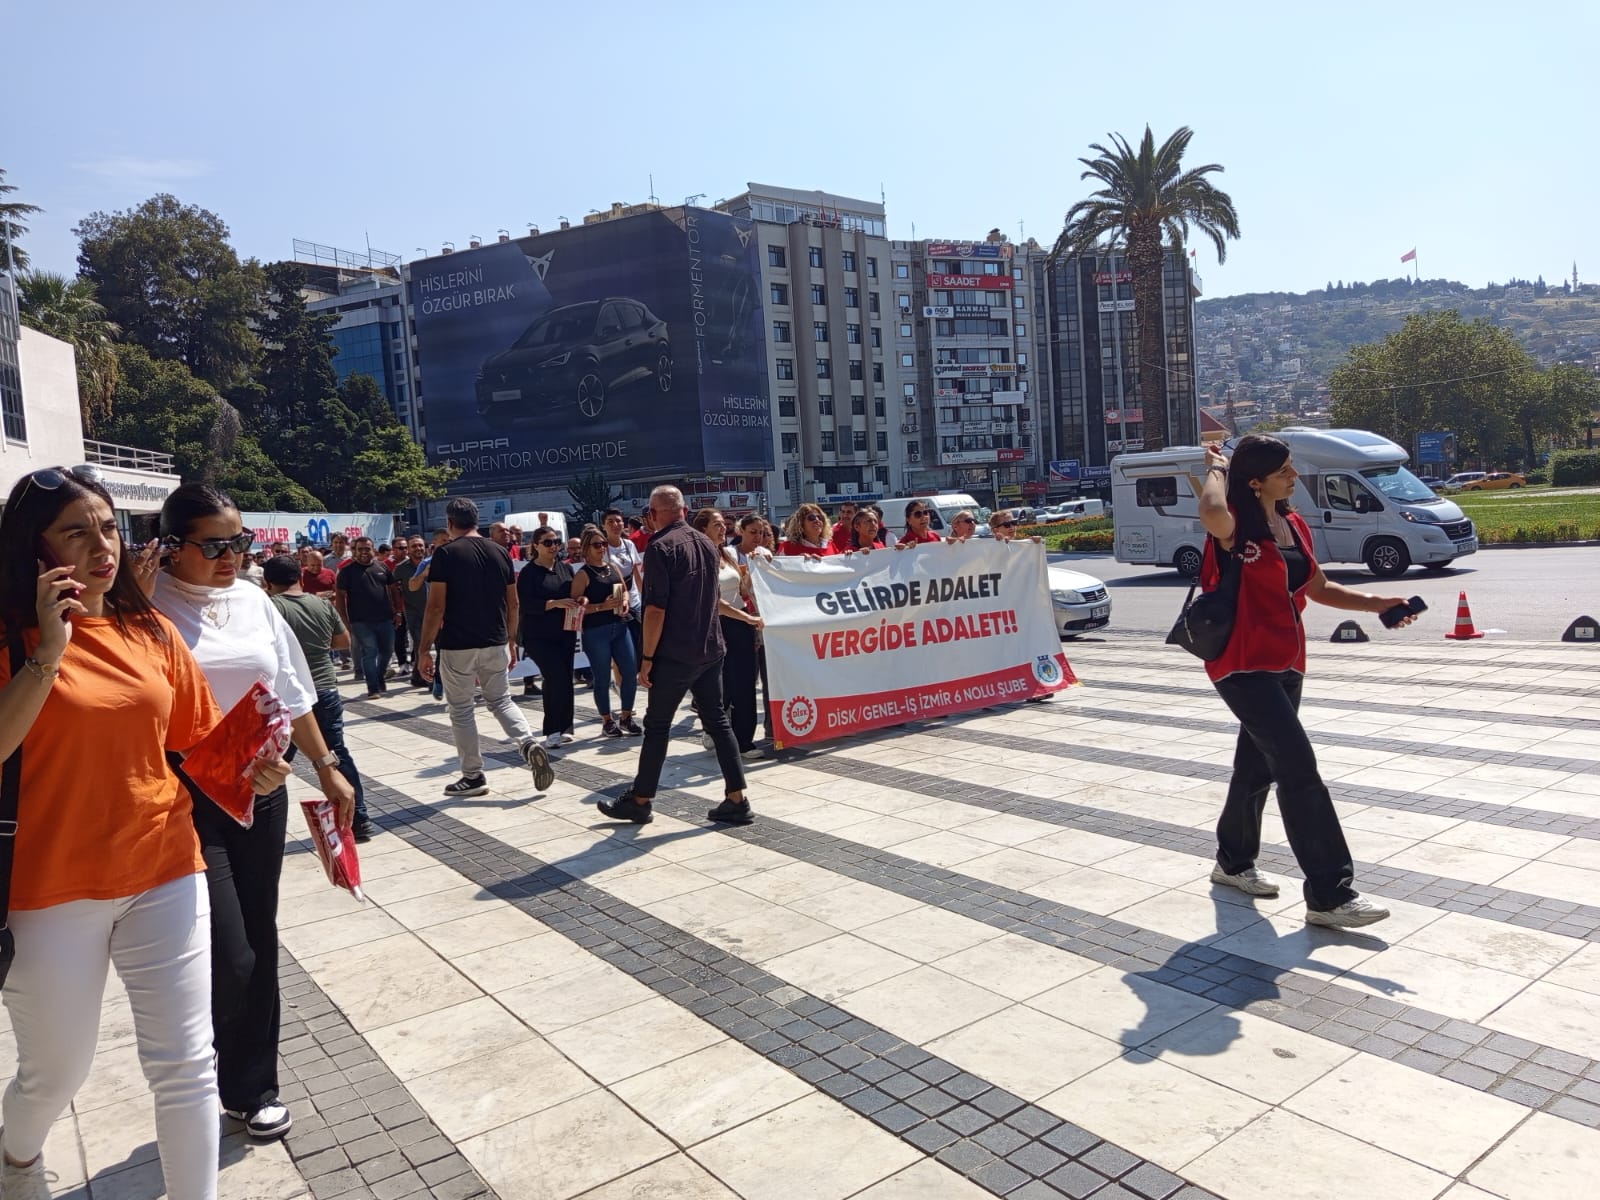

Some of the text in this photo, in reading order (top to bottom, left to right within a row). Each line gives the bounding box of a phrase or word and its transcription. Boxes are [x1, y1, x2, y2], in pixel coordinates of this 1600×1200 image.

[420, 263, 483, 293] HİSLERİNİ
[687, 216, 706, 337] FORMENTOR
[943, 276, 981, 286] SAADET
[422, 284, 515, 315] ÖZGÜR BIRAK
[723, 393, 768, 410] HİSLERİNİ
[703, 410, 769, 427] ÖZGÜR BIRAK
[436, 437, 510, 455] CUPRA
[440, 439, 628, 474] ORMENTOR VOSMER'DE
[815, 572, 1002, 616] GELİRDE ADALET
[811, 609, 1018, 661] VERGİDE ADALET!!
[827, 677, 1028, 729] DİSK/GENEL-İŞ İZMİR 6 NOLU ŞUBE
